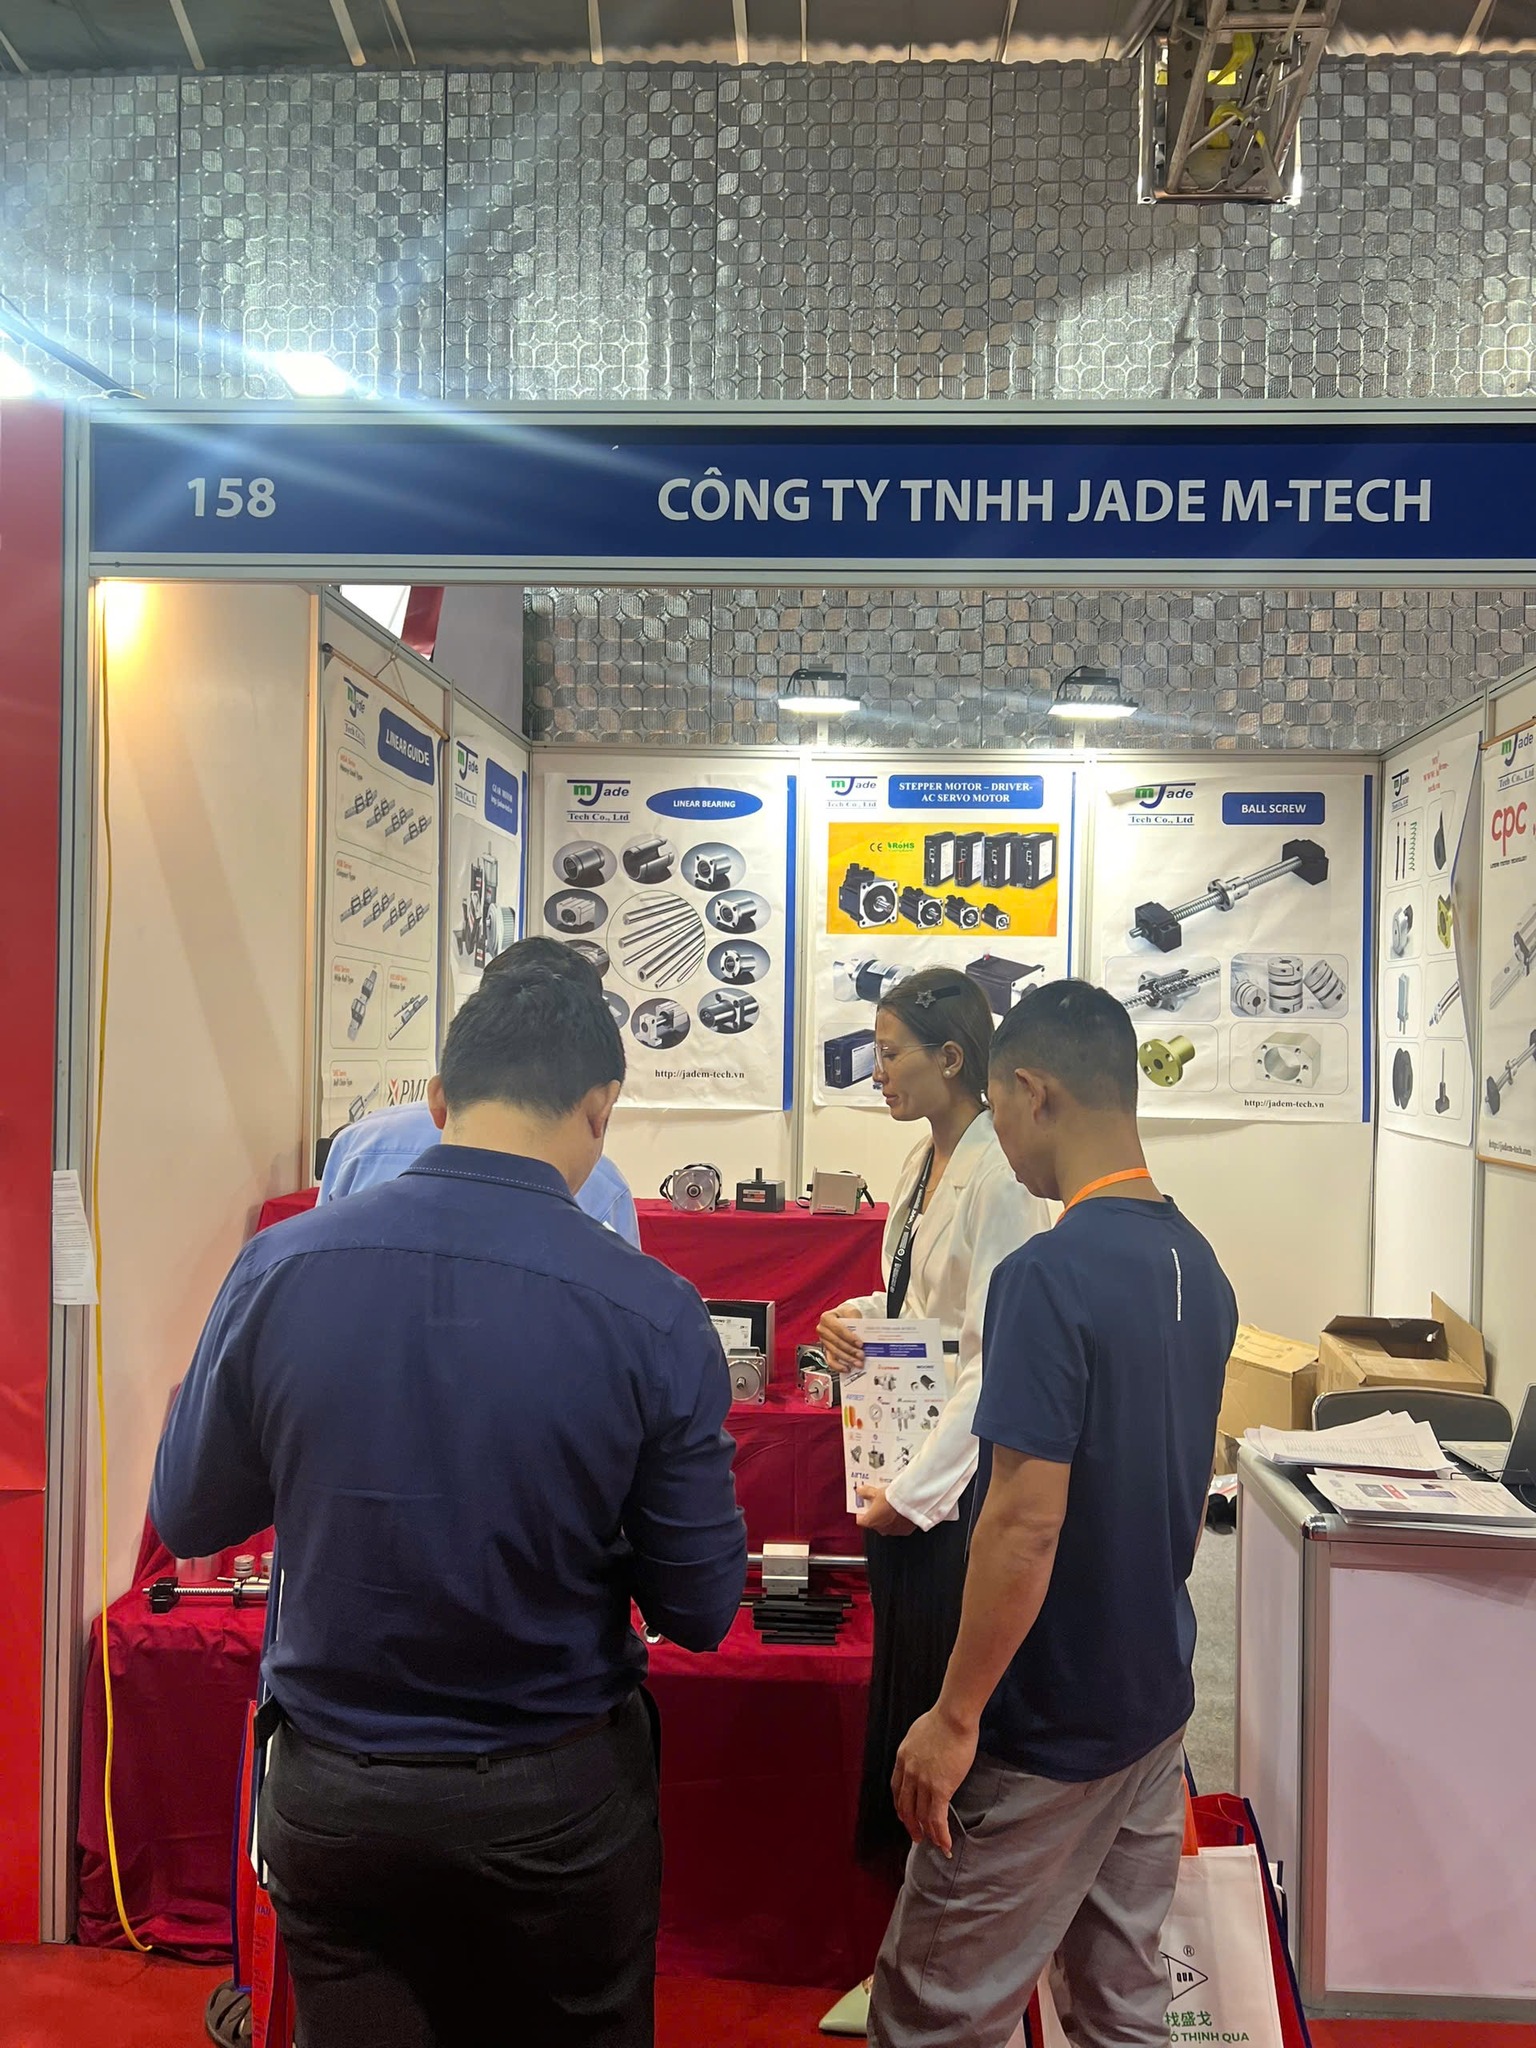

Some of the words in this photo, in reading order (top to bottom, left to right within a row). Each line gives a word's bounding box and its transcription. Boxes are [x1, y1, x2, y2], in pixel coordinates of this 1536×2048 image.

[187, 477, 276, 518] 158
[657, 467, 810, 522] CÔNG
[822, 479, 890, 521] TY
[900, 479, 1054, 521] TNHH
[1067, 479, 1206, 522] JADE
[1221, 478, 1431, 522] M-TECH
[385, 729, 407, 756] LINEAR
[407, 744, 430, 767] GUIDE
[899, 782, 942, 791] STEPPER
[944, 782, 982, 791] MOTOR
[673, 799, 701, 808] LINEAR
[701, 800, 736, 808] BEARING
[921, 794, 936, 802] AC
[937, 794, 970, 802] SERVO
[972, 794, 1010, 802] MOTOR
[1241, 804, 1267, 813] BALL
[1269, 804, 1306, 813] SCREW
[1491, 801, 1527, 857] cpc
[655, 1069, 745, 1079] http://jadem-tech.vn
[400, 1078, 428, 1104] PMI
[1244, 1099, 1325, 1108] http://jadem-tech.vn
[1176, 1972, 1194, 1983] QUA
[1181, 2032, 1219, 2044] THỊNH
[1222, 2032, 1250, 2043] QUA
